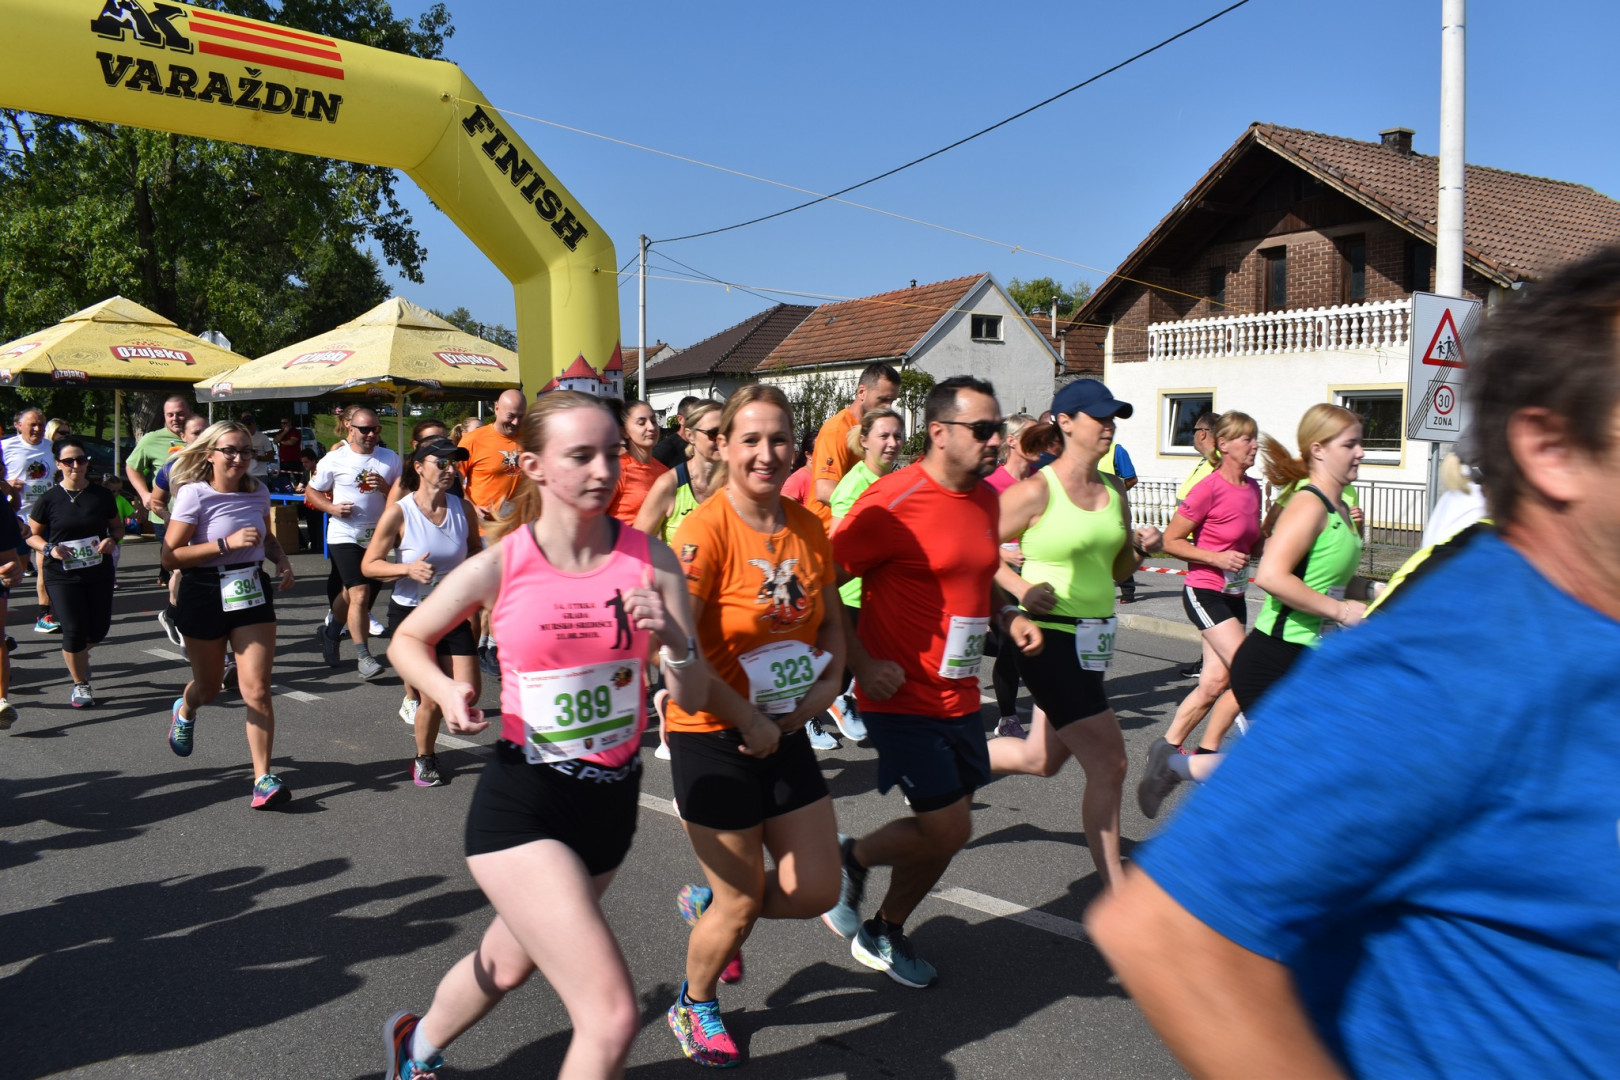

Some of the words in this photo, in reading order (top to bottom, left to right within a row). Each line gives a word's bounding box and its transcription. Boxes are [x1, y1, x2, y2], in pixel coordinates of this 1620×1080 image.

[91, 0, 194, 54] AK
[96, 51, 343, 123] VARAŽDIN
[462, 105, 588, 252] FINISH
[117, 347, 188, 362] Ožujsko
[439, 352, 499, 367] Ožujsko
[1438, 394, 1450, 408] 30
[1433, 416, 1452, 426] ZONA
[32, 485, 47, 494] 380
[234, 578, 257, 596] 394
[770, 655, 815, 689] 323
[554, 684, 612, 727] 389
